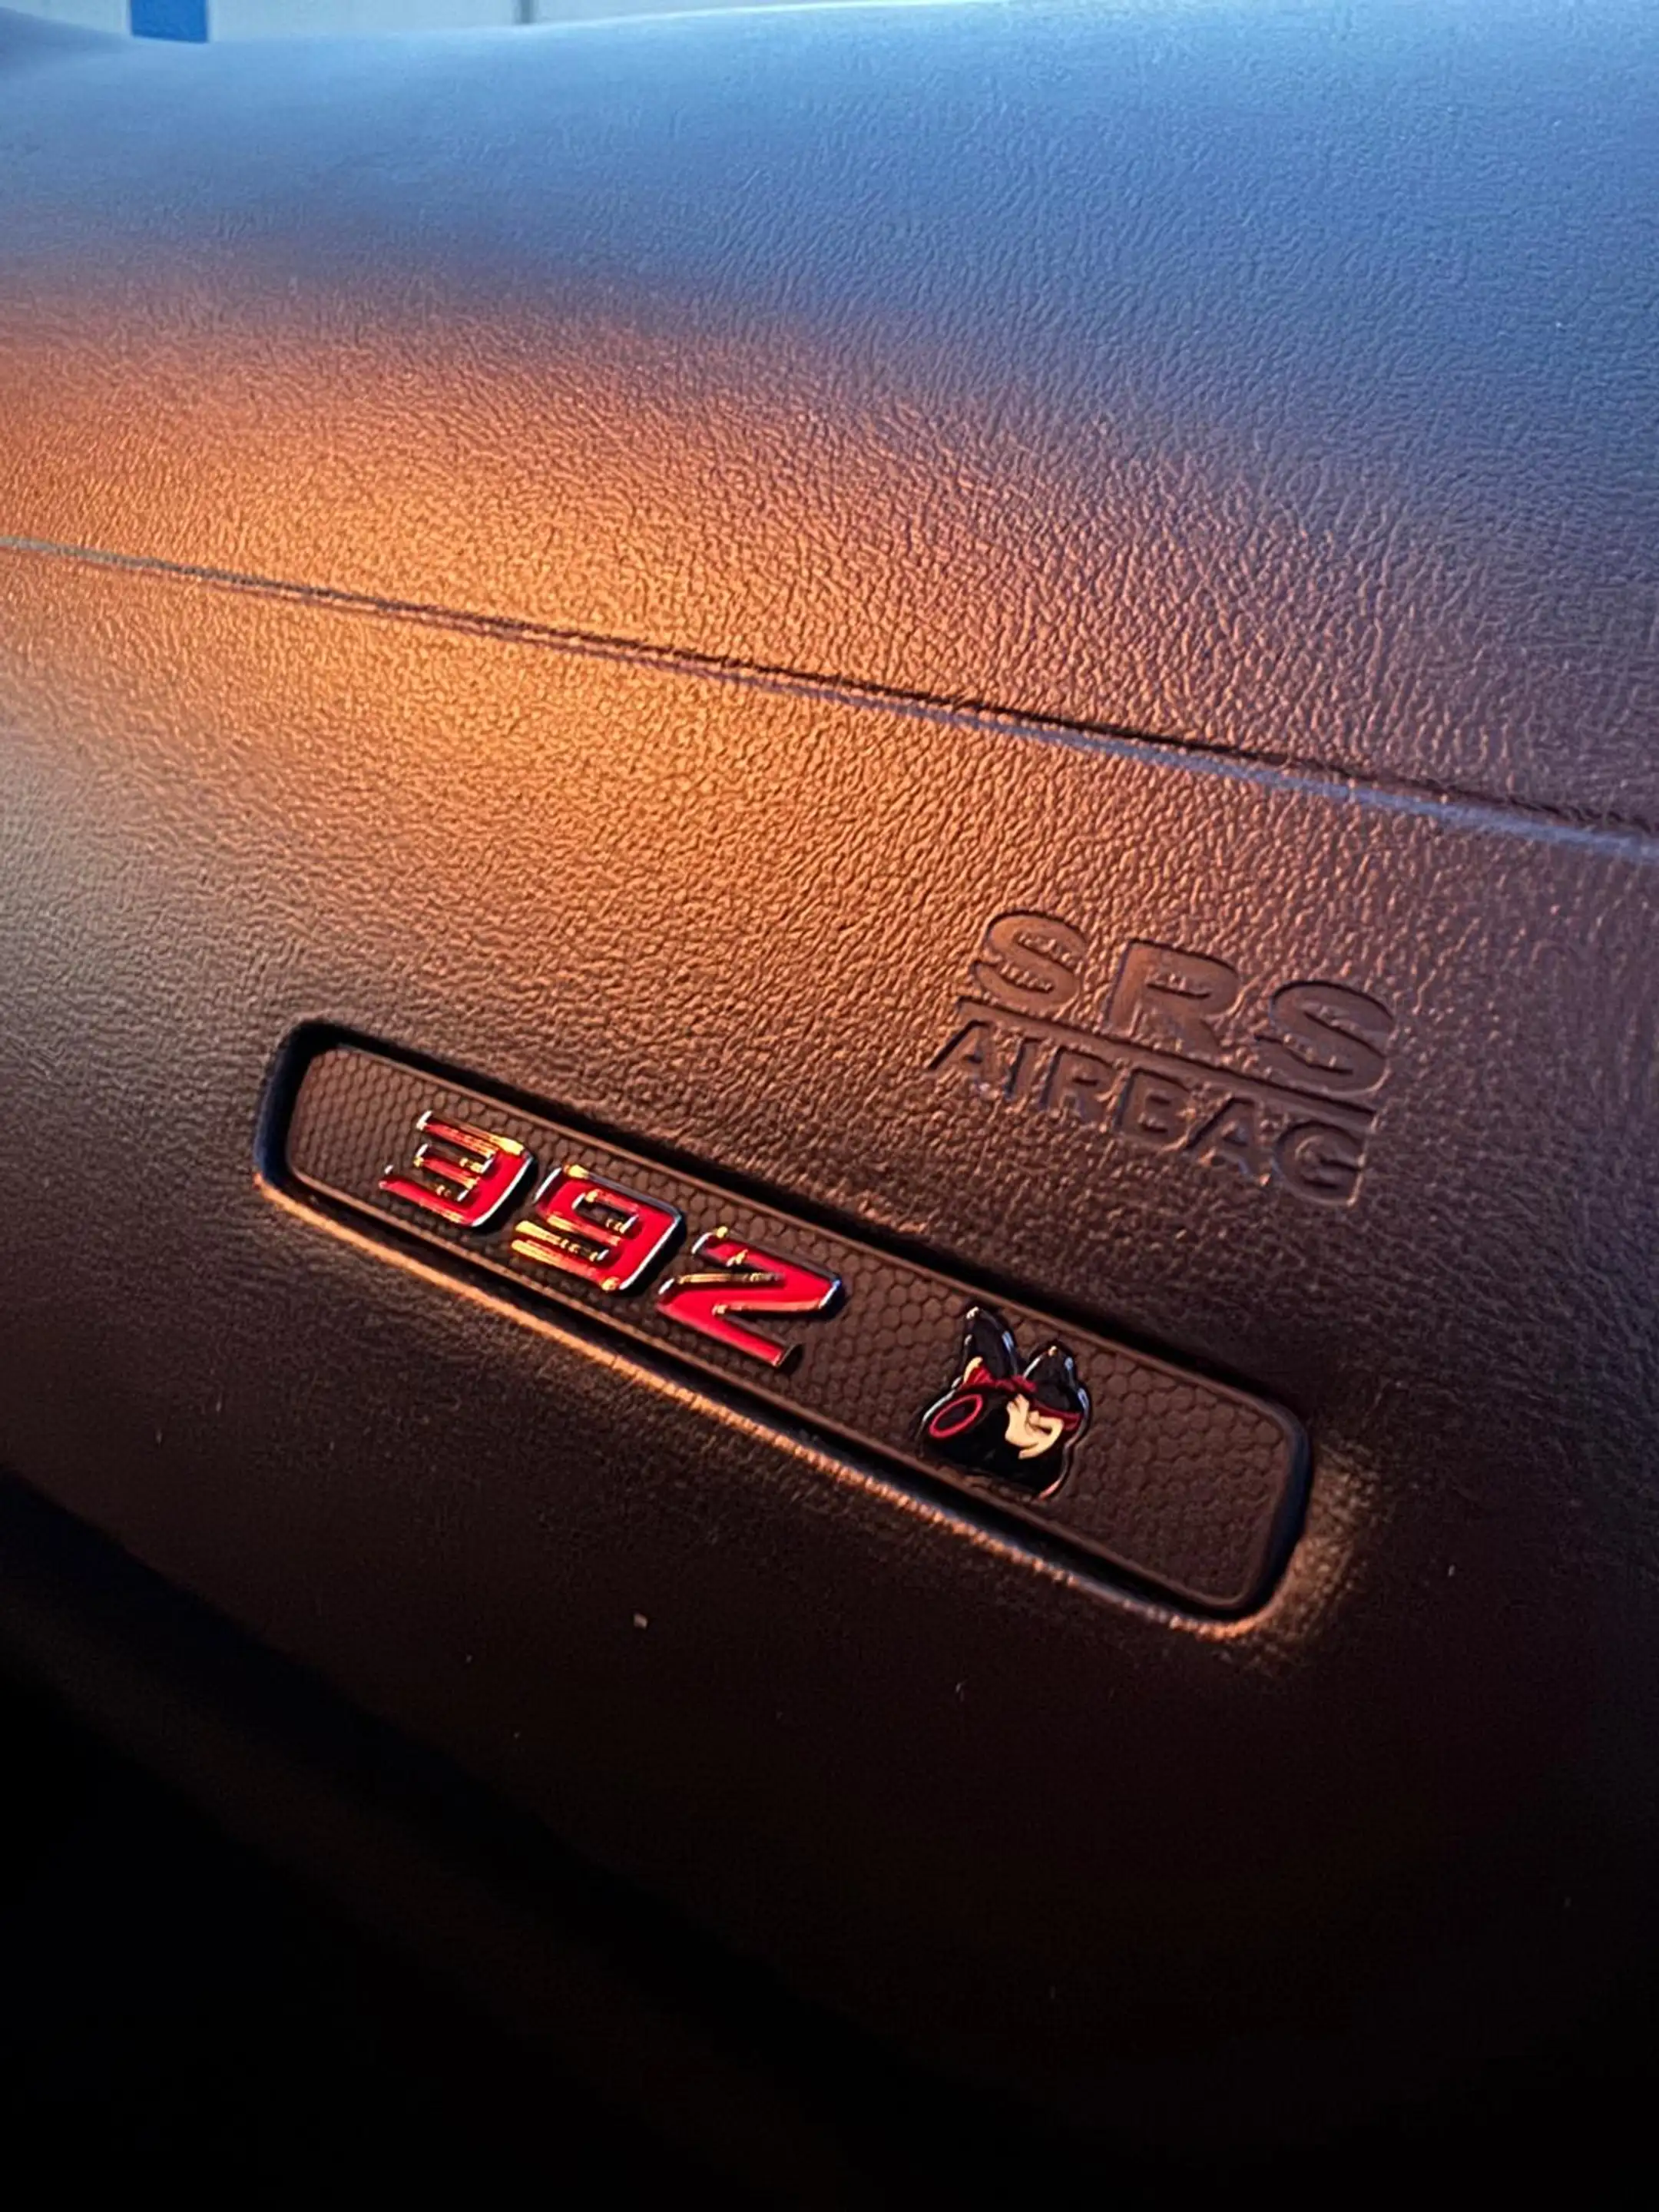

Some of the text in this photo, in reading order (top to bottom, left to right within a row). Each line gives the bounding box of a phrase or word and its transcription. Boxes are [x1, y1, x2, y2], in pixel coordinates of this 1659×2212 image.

[971, 909, 1396, 1098] SRS
[928, 1019, 1376, 1207] AIRBAG
[379, 1111, 843, 1369] 392
